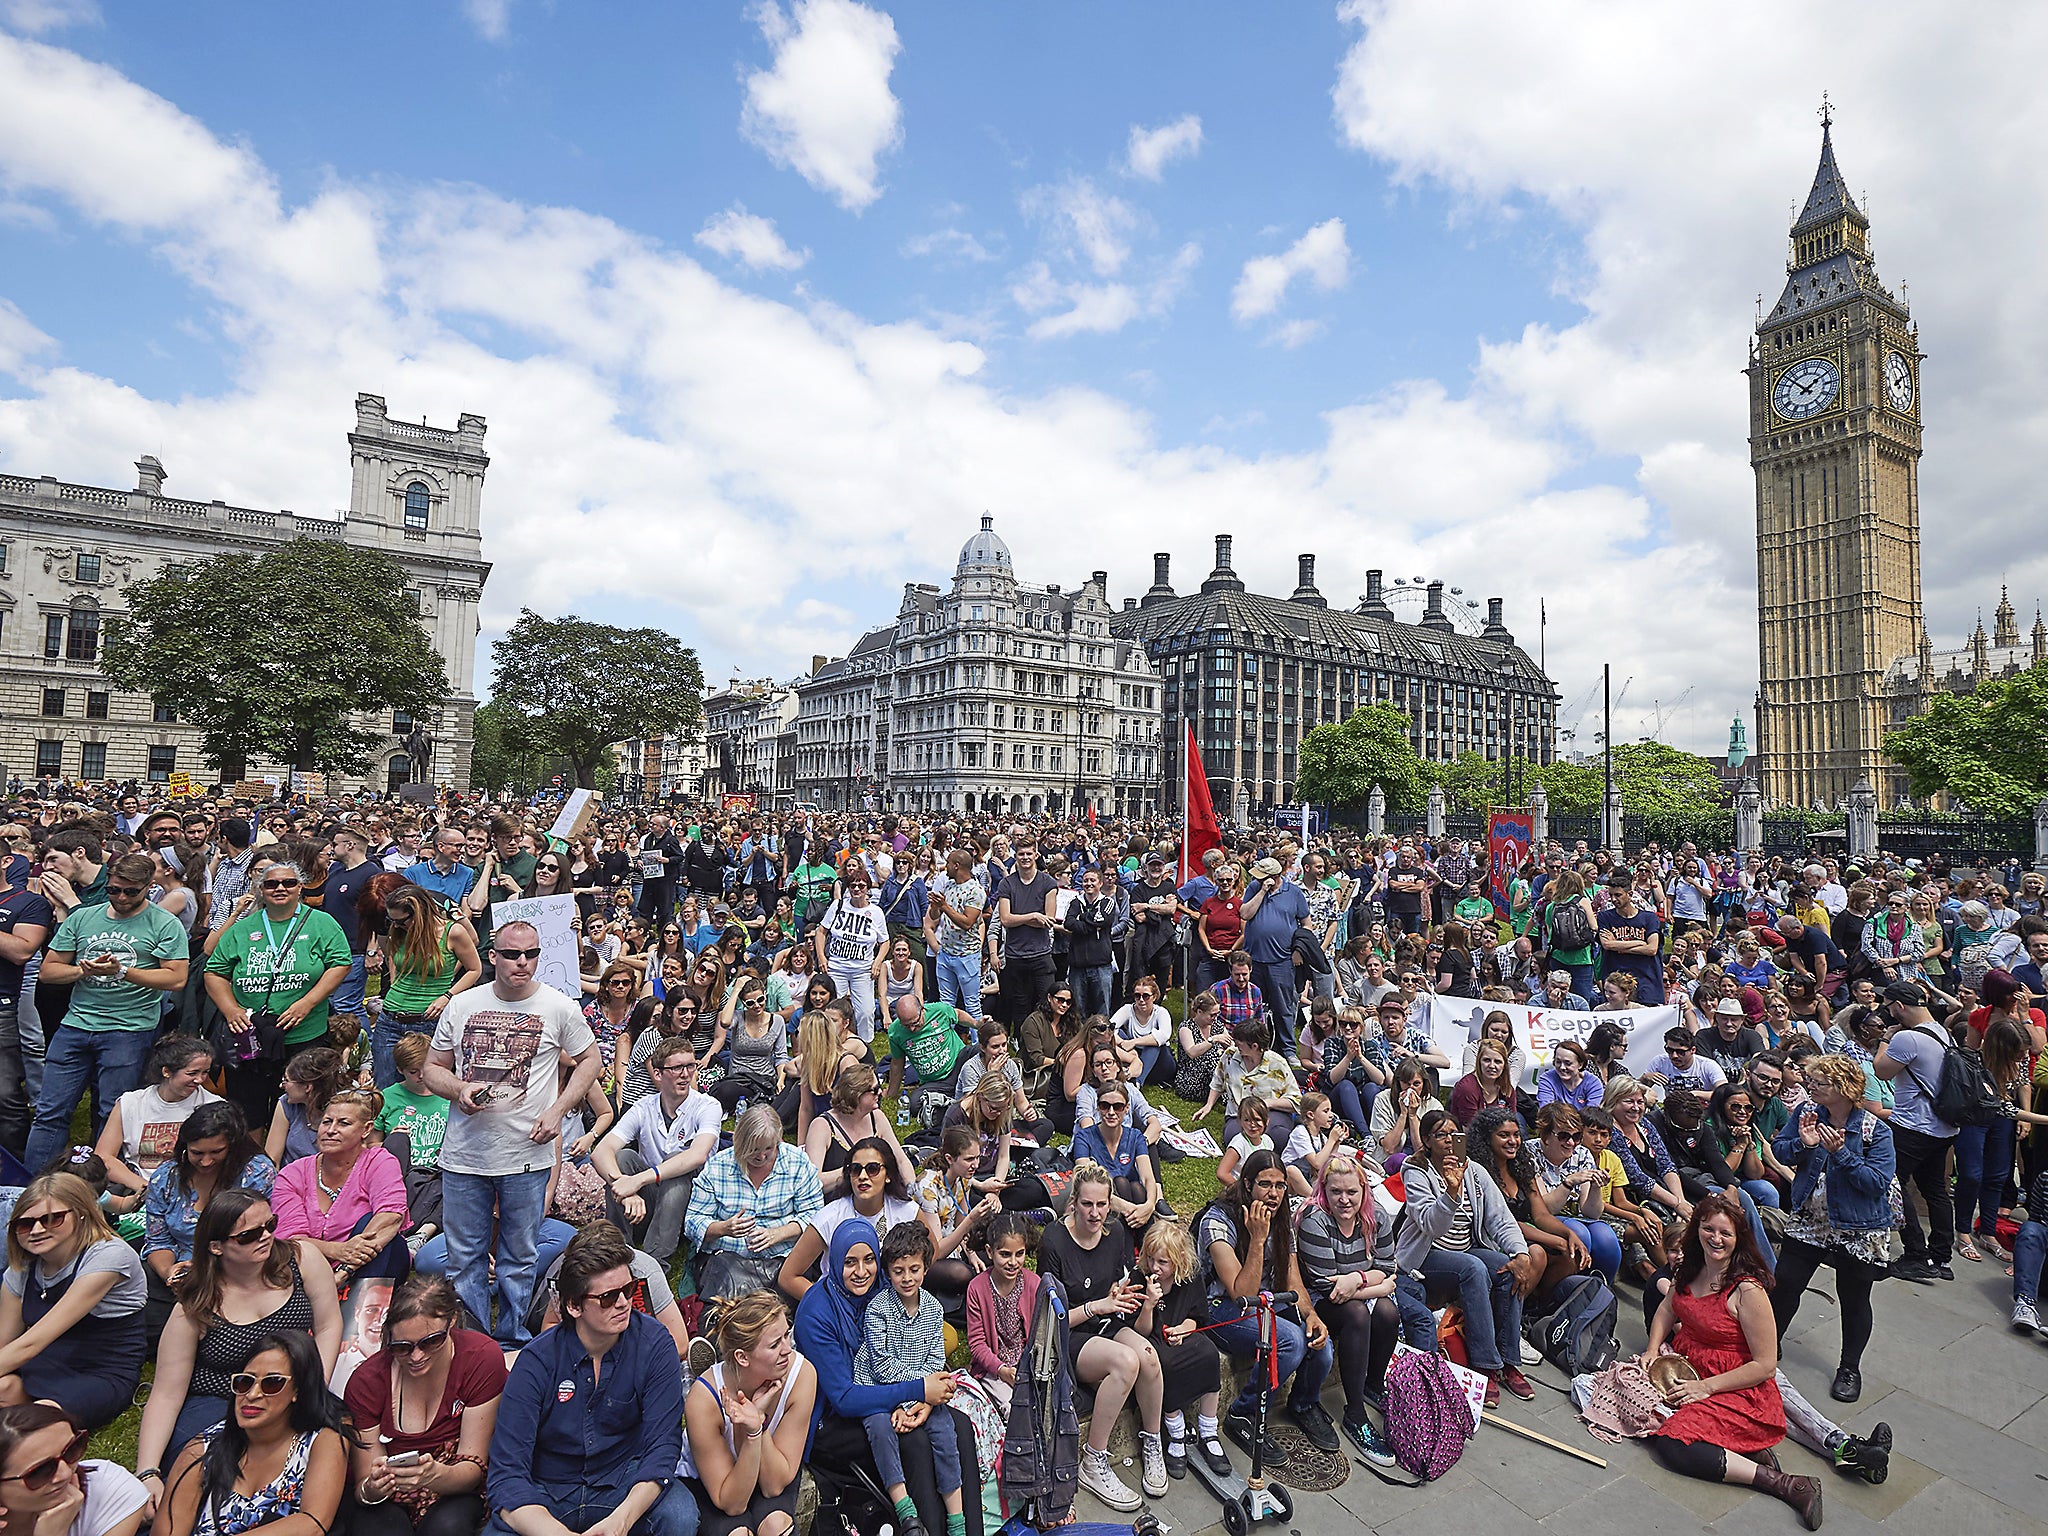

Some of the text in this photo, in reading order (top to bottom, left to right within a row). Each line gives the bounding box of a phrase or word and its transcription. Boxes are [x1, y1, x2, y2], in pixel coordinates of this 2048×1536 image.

[834, 910, 872, 936] SAVE
[87, 932, 138, 945] MANLY
[842, 933, 857, 942] OUR
[237, 977, 270, 986] STAND
[289, 973, 310, 981] FOR
[1259, 1391, 1267, 1434] micro
